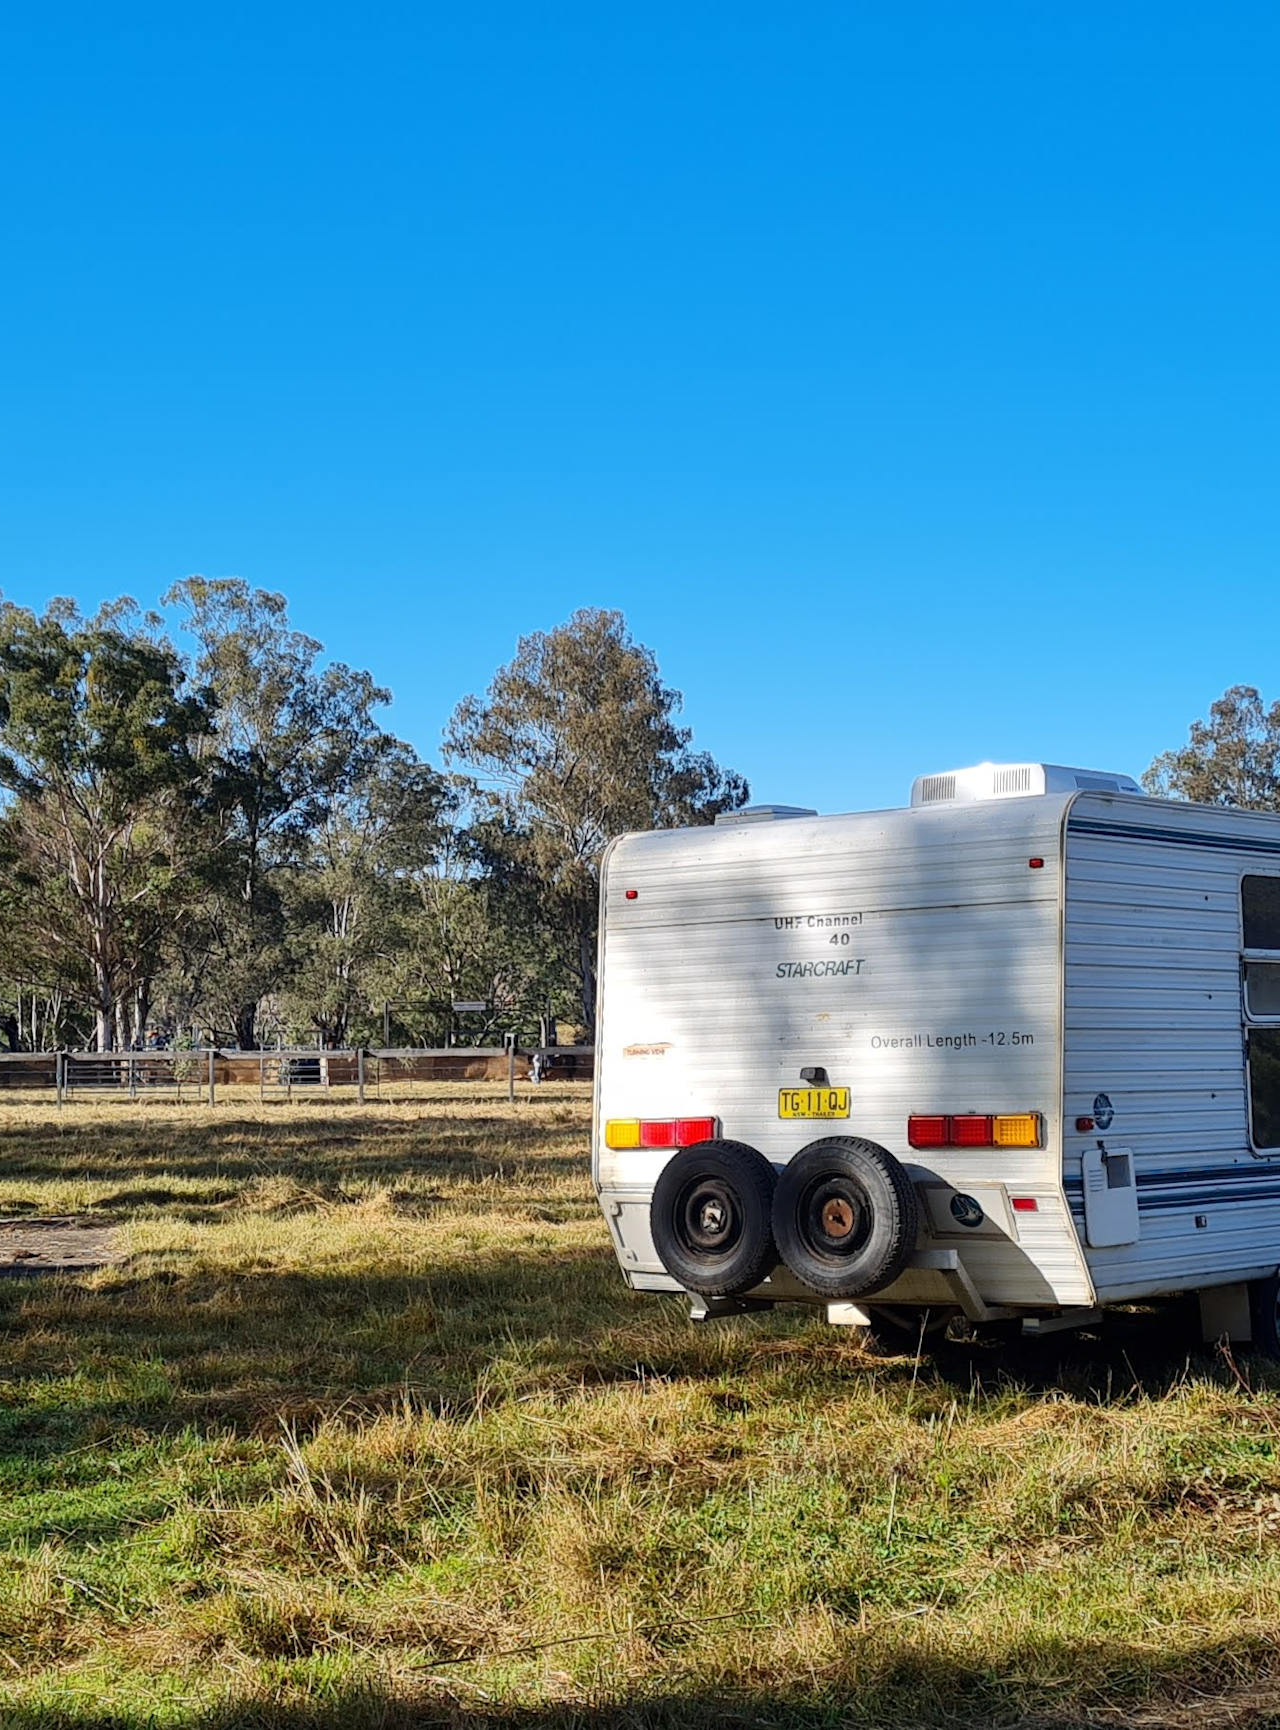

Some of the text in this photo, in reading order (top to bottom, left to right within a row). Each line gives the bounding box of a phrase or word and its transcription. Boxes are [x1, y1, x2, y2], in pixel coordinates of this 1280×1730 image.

[829, 933, 850, 945] 40
[776, 959, 866, 978] STARCRAFT
[871, 1034, 922, 1049] Overall
[927, 1033, 977, 1049] Length
